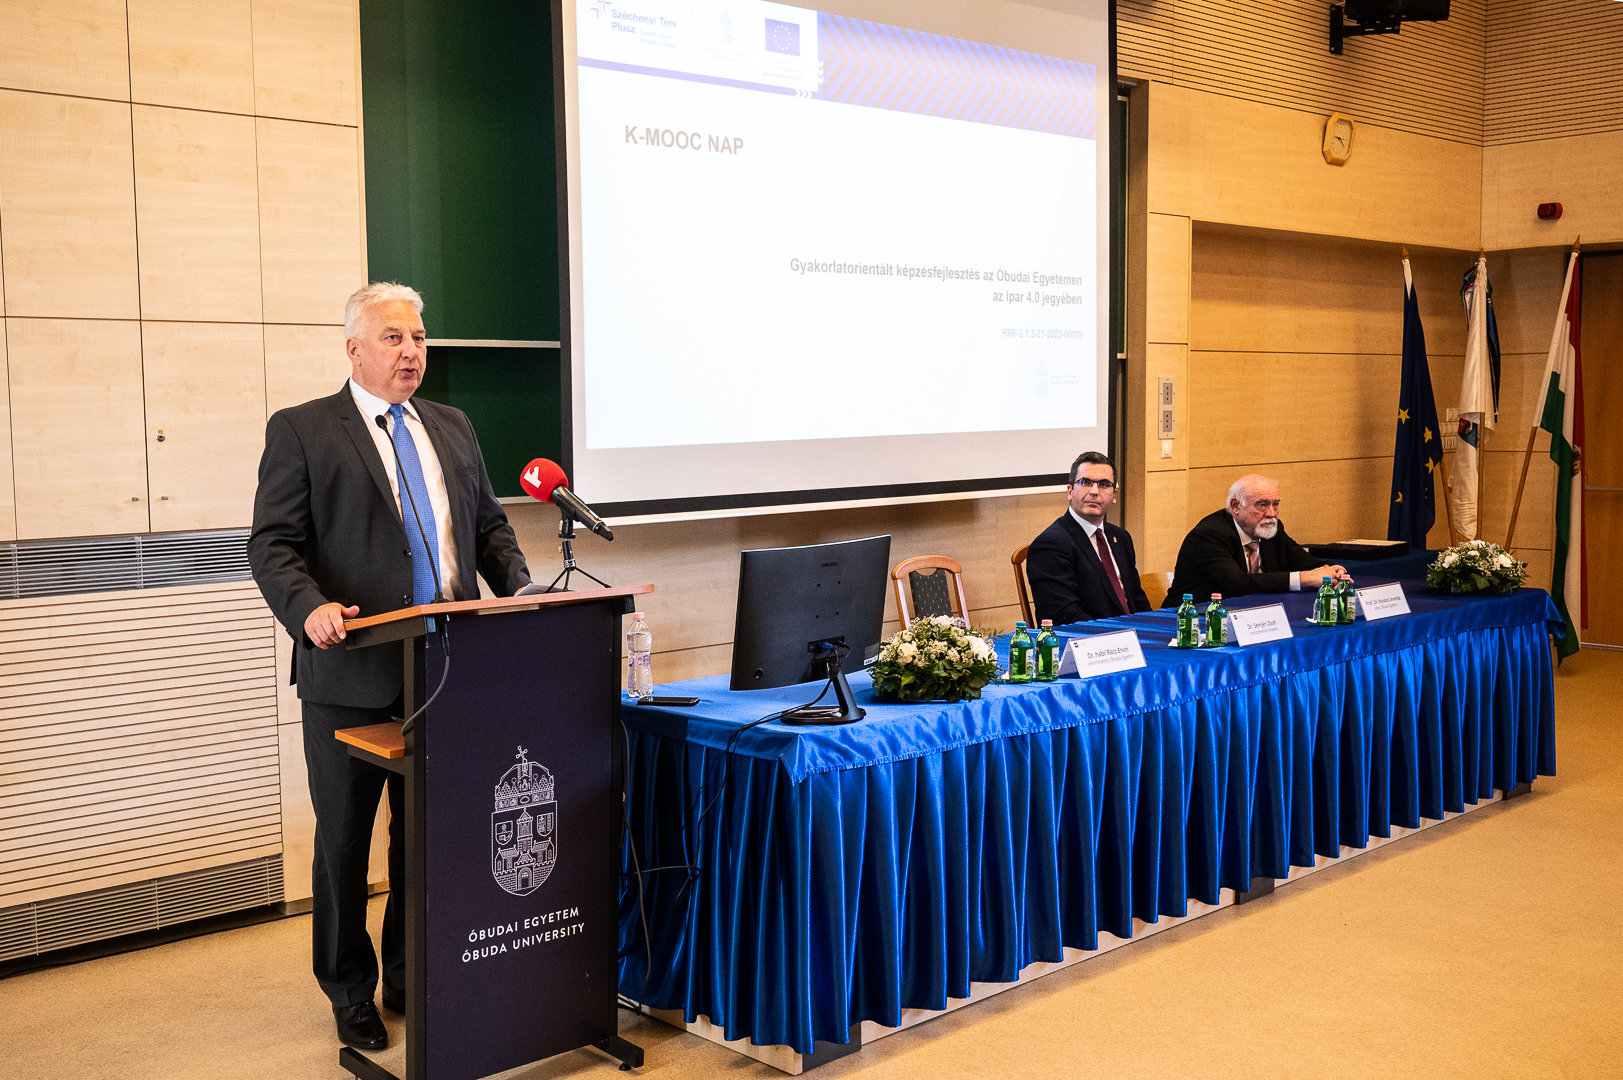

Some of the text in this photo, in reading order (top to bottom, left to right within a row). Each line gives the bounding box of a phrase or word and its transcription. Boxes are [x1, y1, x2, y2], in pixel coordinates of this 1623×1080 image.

[611, 9, 677, 28] Széchenyi Terv
[611, 21, 636, 34] Plusz
[625, 125, 744, 155] K-MOOC NAP
[790, 258, 1083, 287] Gyakorlatorientált képzésfejlesztés az Óbudai Egyetemen
[993, 290, 1083, 307] az Ipar 4.0 jegyében
[468, 906, 580, 943] ÓBUDAI EGYETEM
[461, 922, 585, 963] ÓBUDA UNIVERSITY
